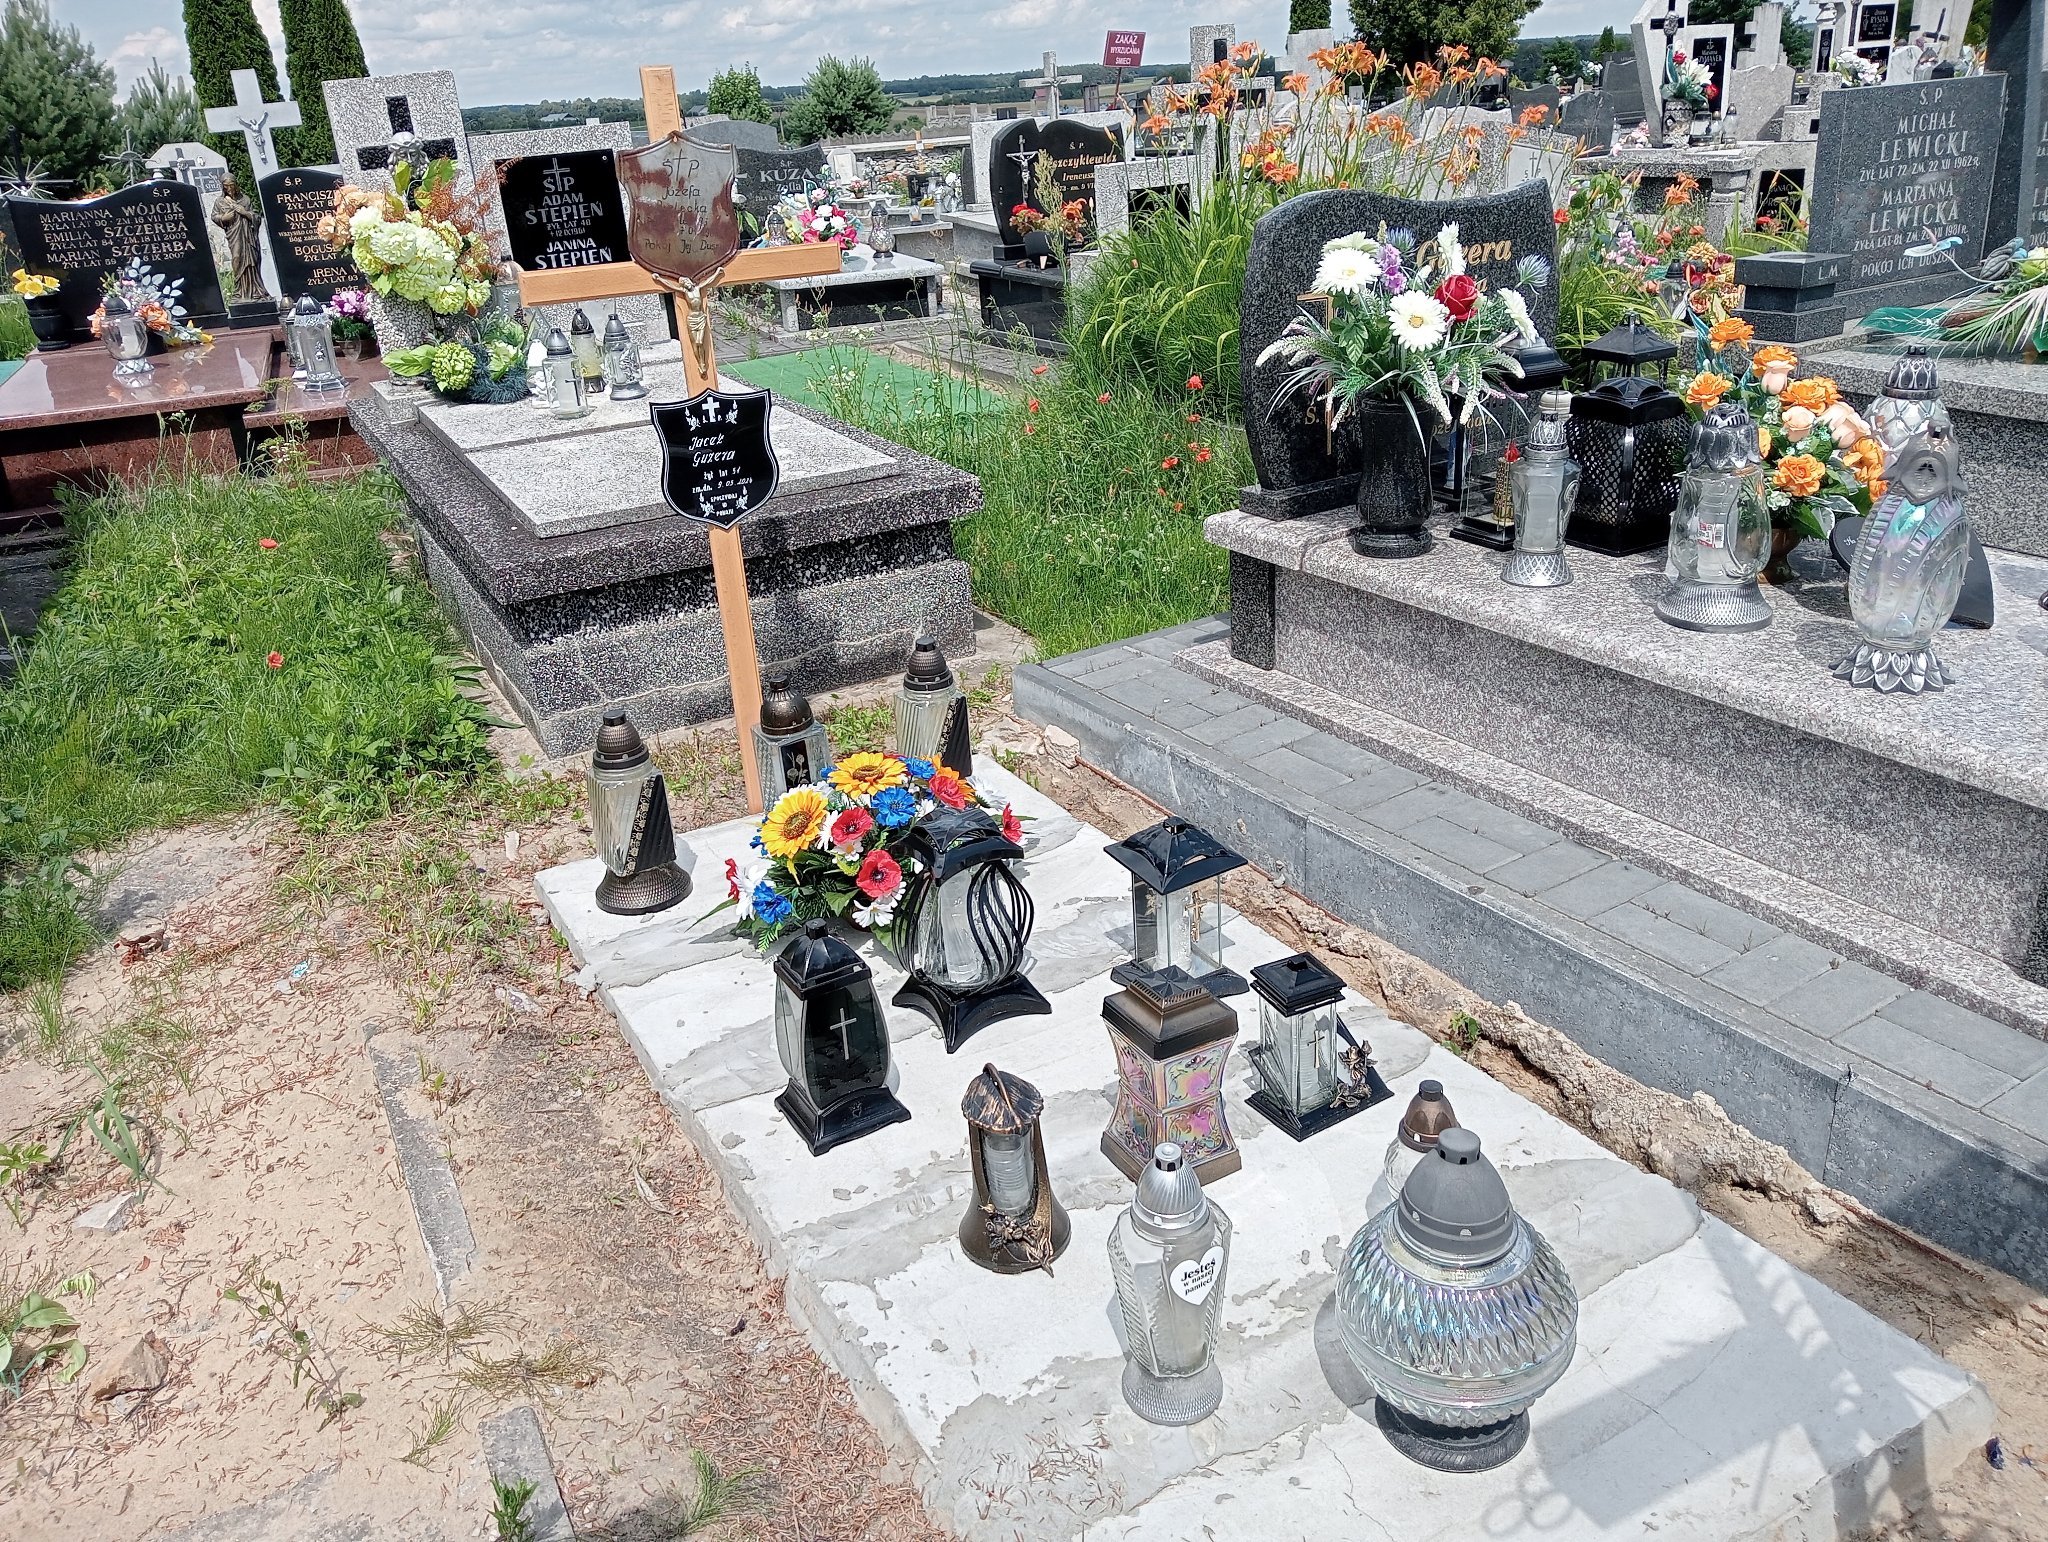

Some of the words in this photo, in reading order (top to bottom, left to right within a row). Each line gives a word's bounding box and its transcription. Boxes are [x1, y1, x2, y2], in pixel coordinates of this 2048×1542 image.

[1115, 35, 1137, 44] ZAKAZ
[1897, 110, 1957, 135] MICHAŁ
[1879, 130, 1968, 163] LEWICKI
[760, 168, 815, 182] KUZA
[1860, 168, 1876, 181] ŻYŁ
[1878, 166, 1895, 178] LAT
[1897, 164, 1907, 176] 72
[1928, 161, 1939, 171] 22
[543, 193, 583, 206] ADAM
[1882, 180, 1954, 206] MARIANNA
[40, 209, 112, 224] MARIANNA
[122, 202, 183, 216] WÓJCIK
[95, 219, 107, 227] 90
[135, 216, 144, 224] 16
[164, 213, 184, 222] 1975
[1870, 200, 1958, 234] LEWICKA
[45, 231, 92, 243] EMILIA
[104, 221, 188, 238] SZCZERBA
[102, 238, 113, 246] 84
[163, 232, 186, 240] 2003
[47, 250, 101, 263] MARIAN
[112, 240, 196, 258] SZCZERBA
[547, 238, 596, 253] JANINA
[84, 259, 102, 267] LAT
[163, 252, 185, 260] 2007
[1861, 259, 1893, 277] POKÓJ
[1898, 257, 1914, 270] ICH
[313, 267, 347, 278] IRENA
[689, 433, 724, 451] Jacek
[693, 450, 735, 467] Guzera
[1181, 1257, 1215, 1281] Jesteś
[1192, 1265, 1213, 1283] naszej
[1185, 1277, 1212, 1295] pamięci
